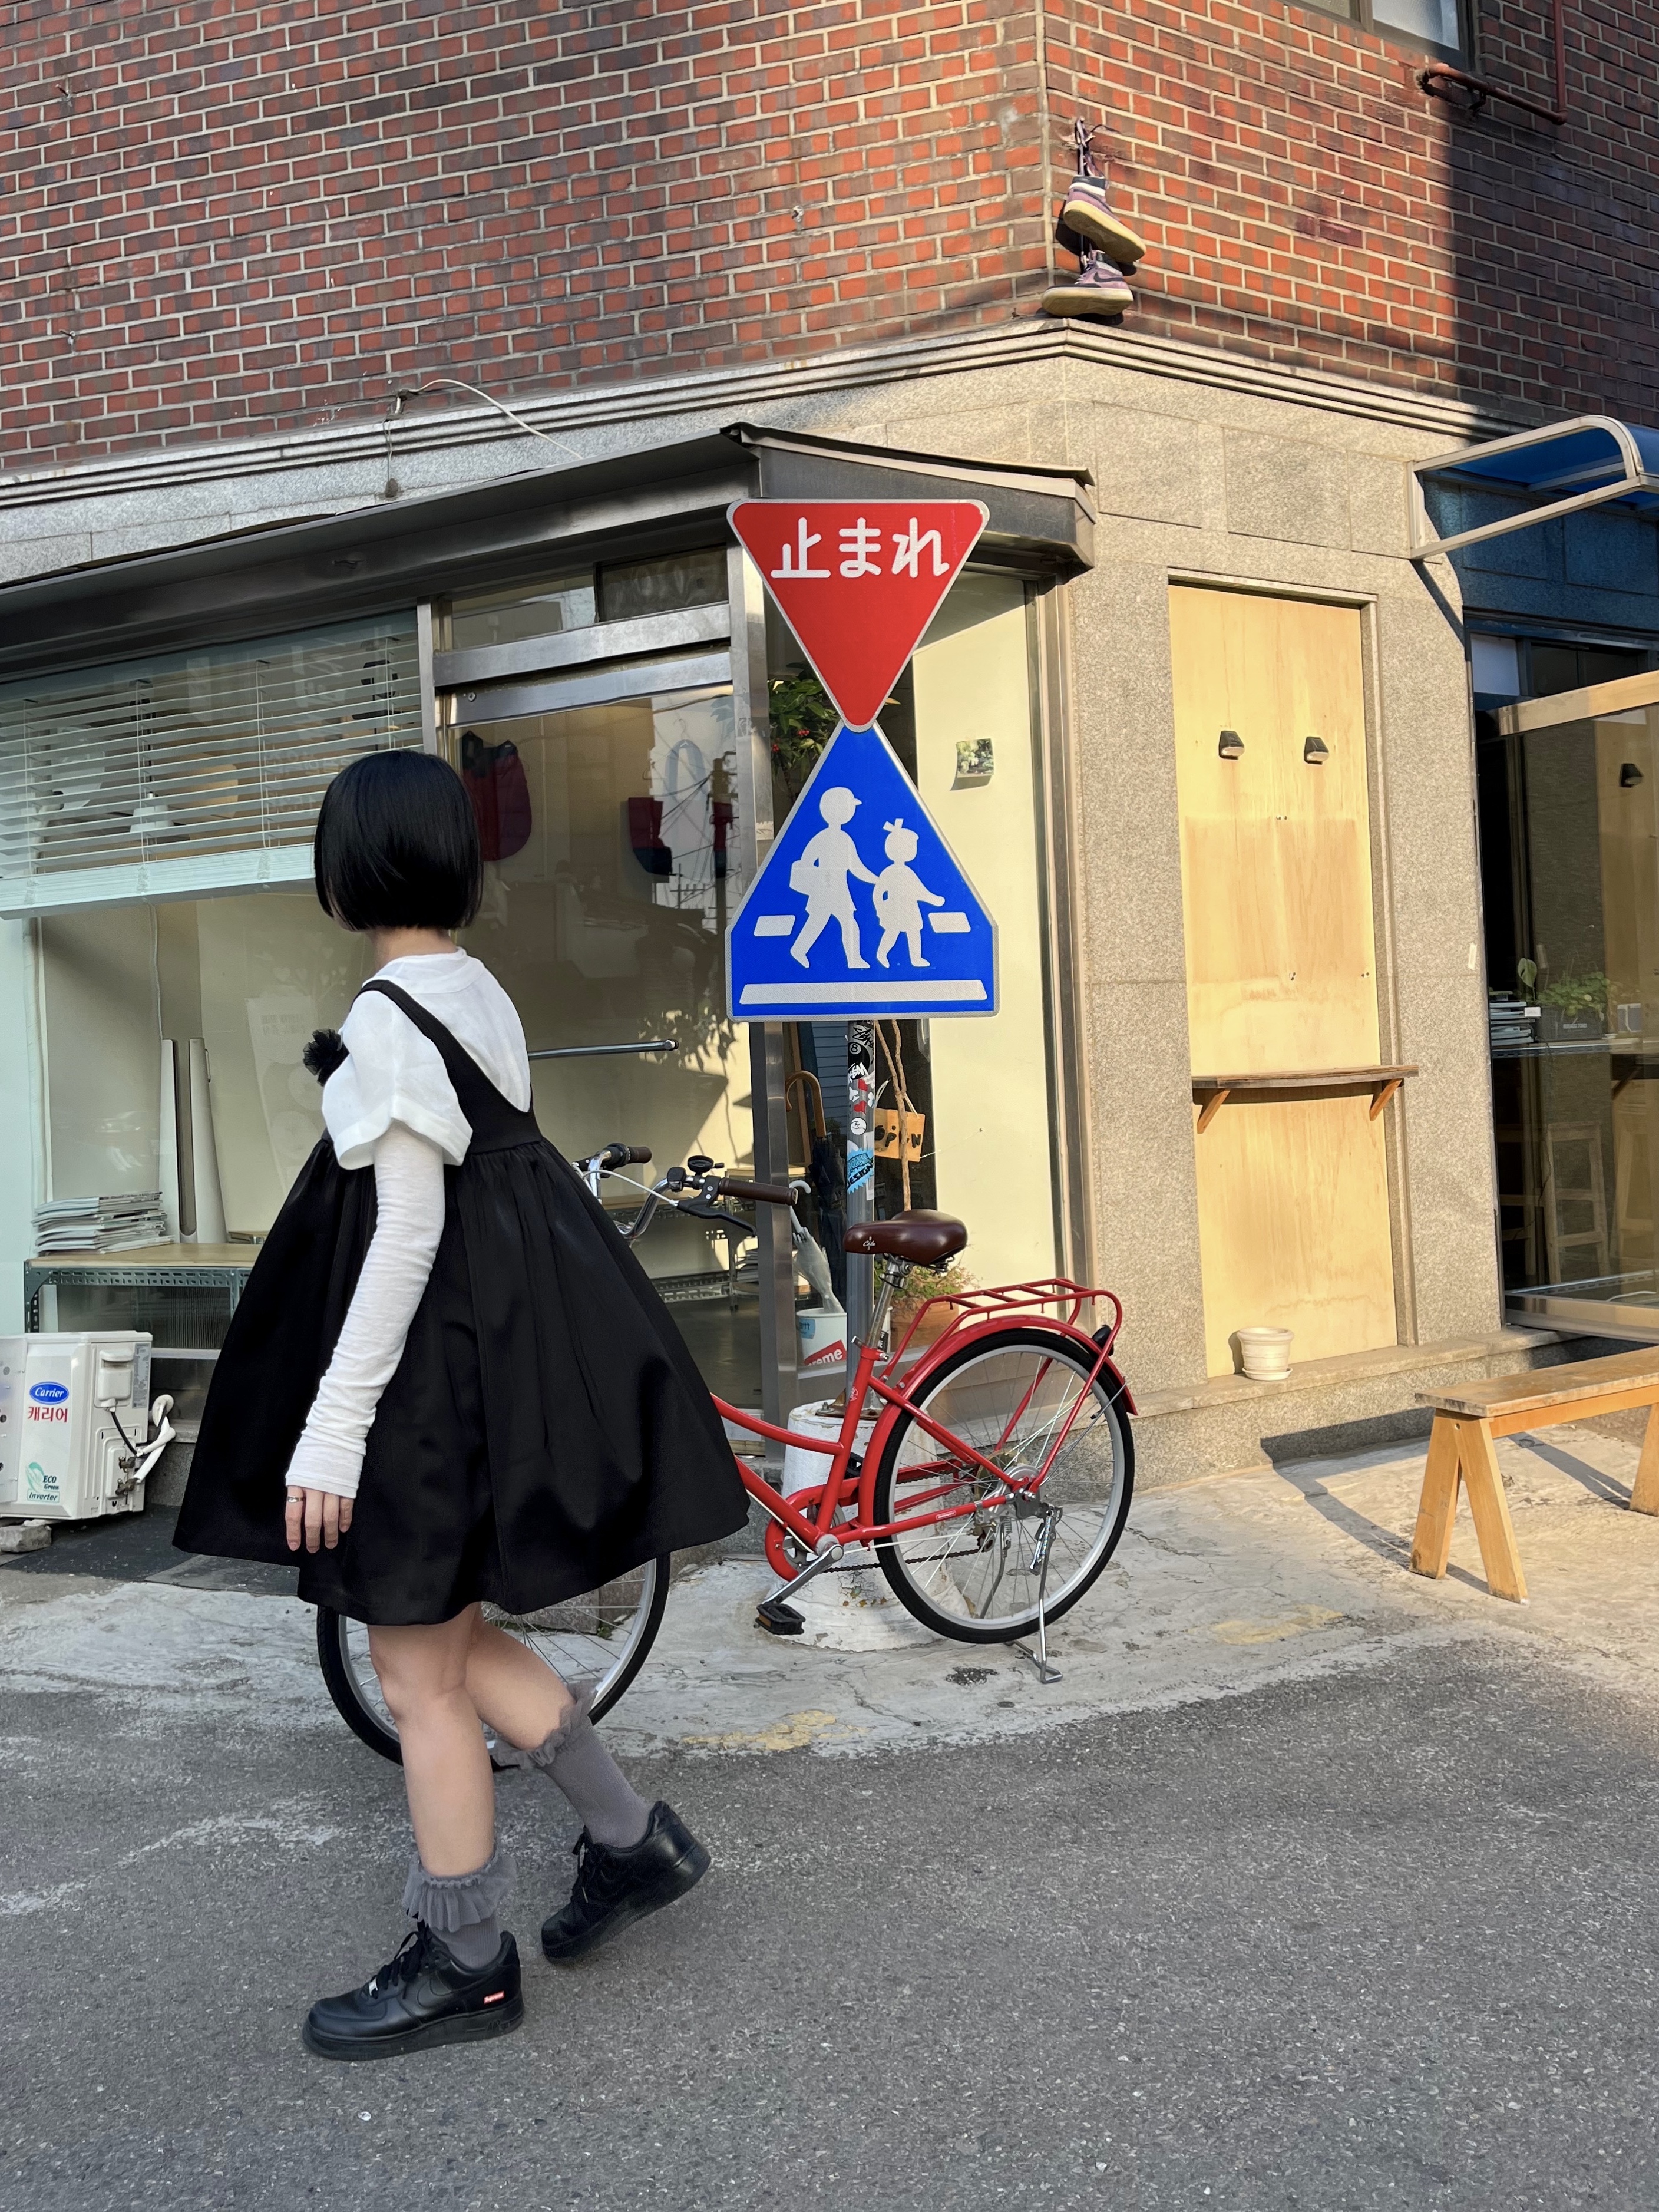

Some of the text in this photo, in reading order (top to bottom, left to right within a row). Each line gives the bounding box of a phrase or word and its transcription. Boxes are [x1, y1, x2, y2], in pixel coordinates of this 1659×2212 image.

[770, 517, 950, 579] 止まれ
[850, 1044, 858, 1053] 8
[874, 1125, 921, 1148] OPN
[35, 1386, 64, 1398] Carrier
[28, 1406, 68, 1423] 캐리어
[43, 1475, 57, 1484] ECO
[29, 1491, 58, 1501] Inverter
